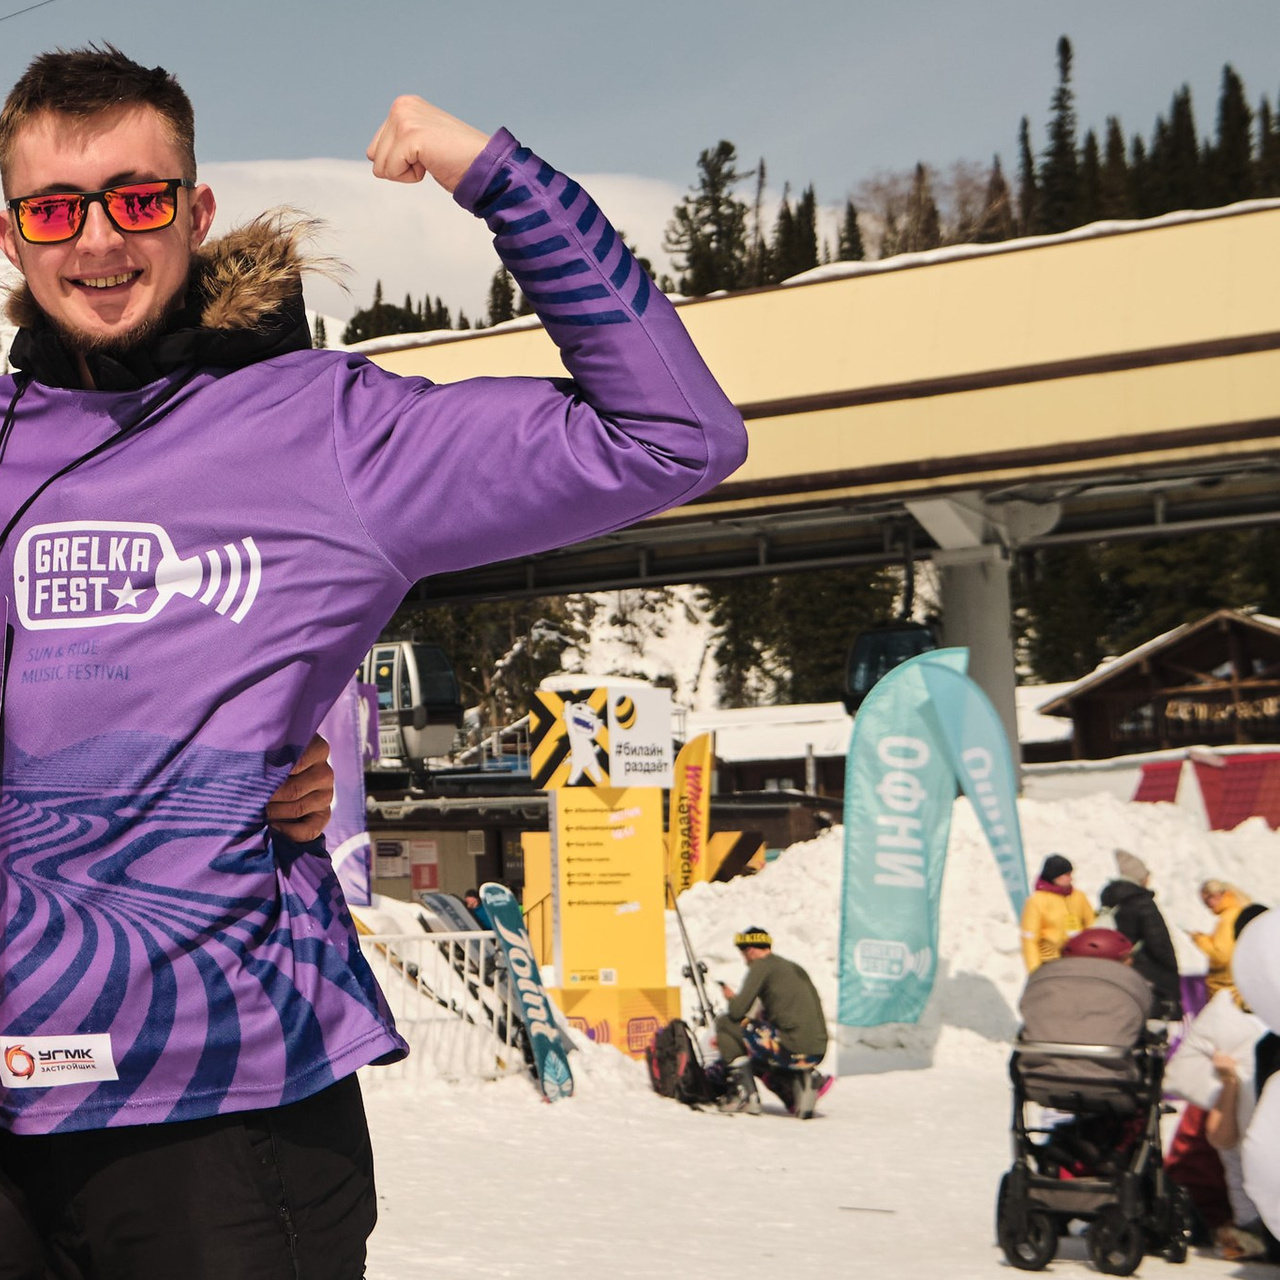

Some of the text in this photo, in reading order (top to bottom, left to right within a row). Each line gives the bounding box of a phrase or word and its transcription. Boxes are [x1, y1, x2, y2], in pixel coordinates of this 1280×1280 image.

[35, 536, 151, 574] GRELKA
[35, 577, 109, 614] FEST
[26, 639, 100, 663] SUN & RIDE
[21, 664, 131, 684] MUSIC FESTIVAL
[615, 742, 664, 757] #билайн
[624, 760, 669, 776] раздаёт
[873, 735, 930, 889] ИНФО
[38, 1048, 93, 1061] УГМК
[41, 1062, 96, 1073] ЗАСТРОЙЩИК
